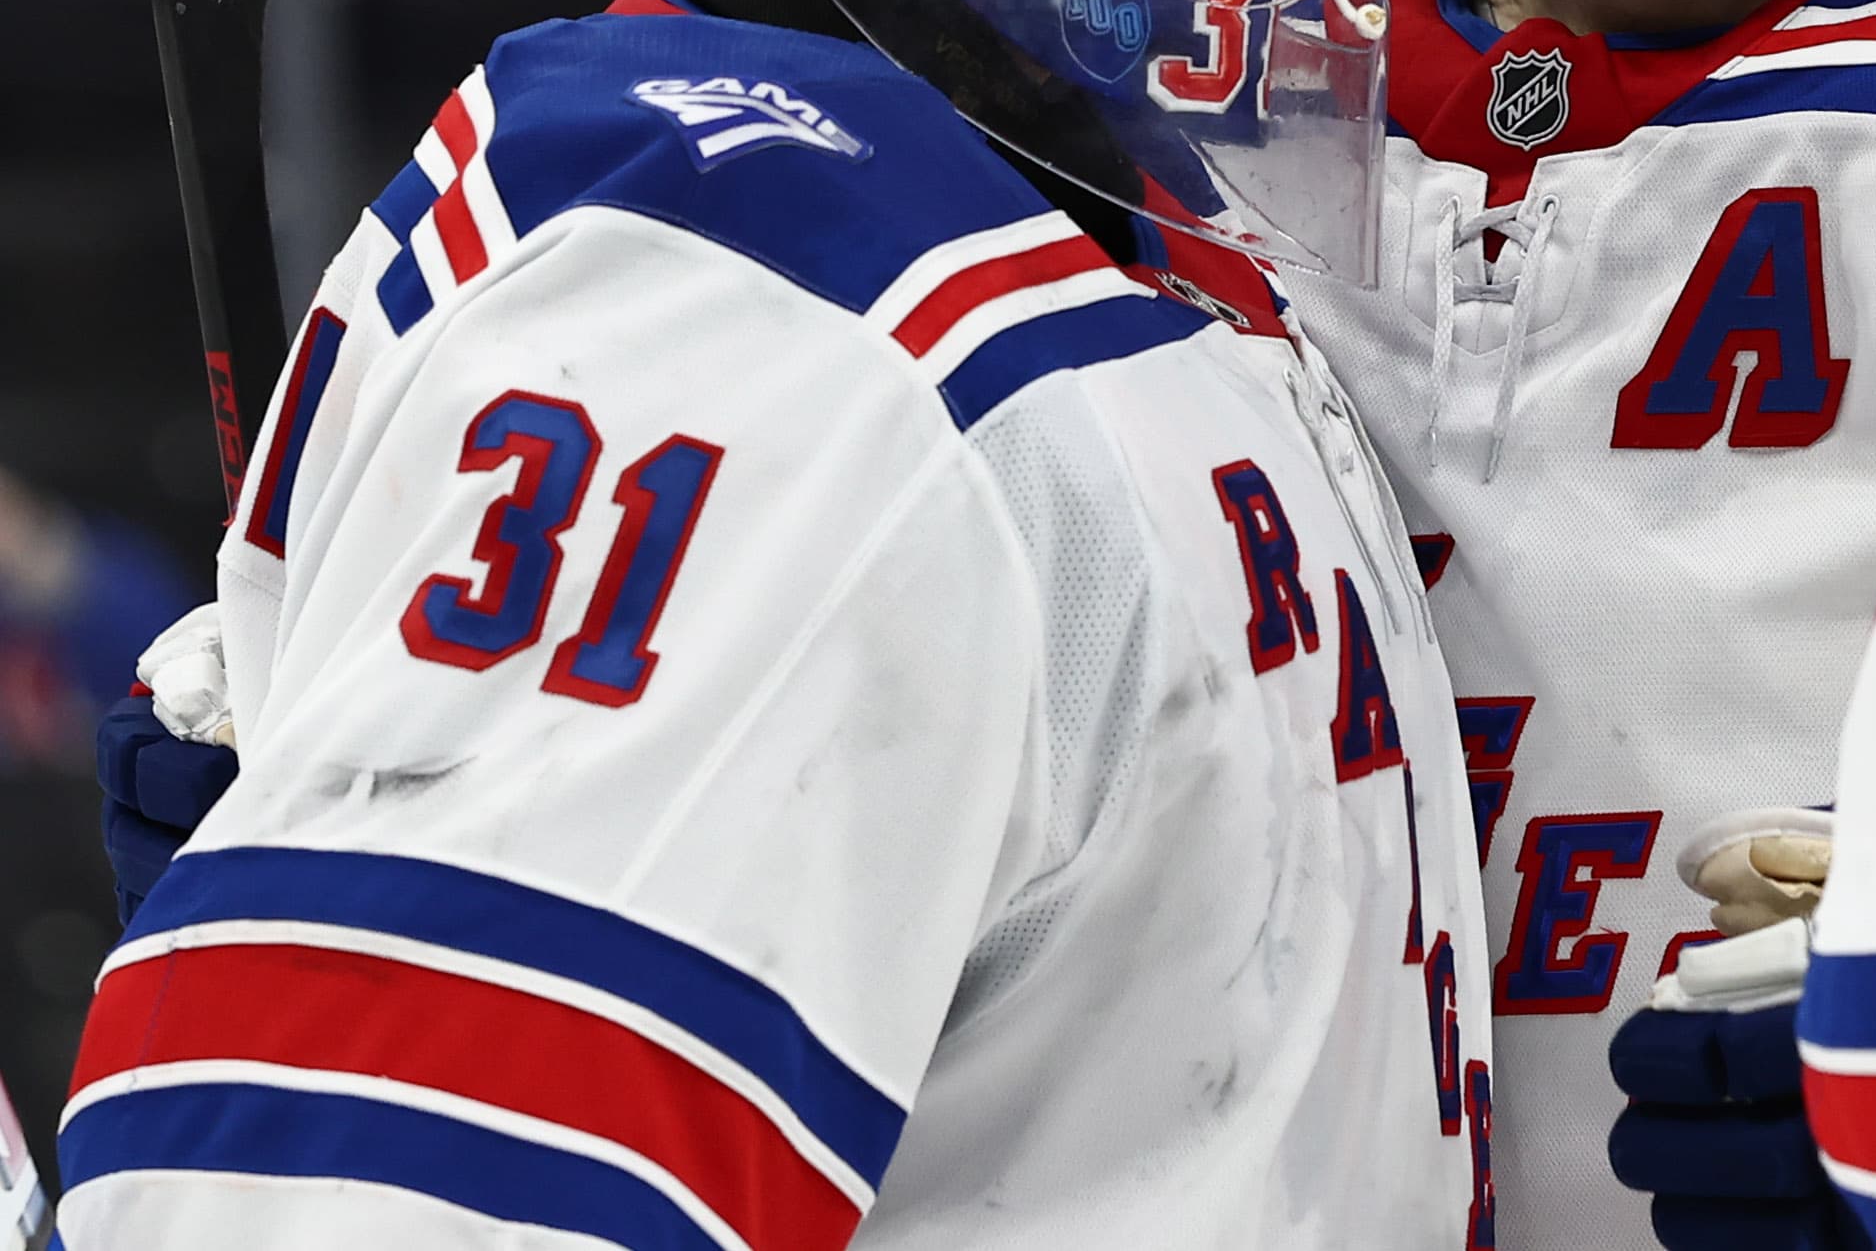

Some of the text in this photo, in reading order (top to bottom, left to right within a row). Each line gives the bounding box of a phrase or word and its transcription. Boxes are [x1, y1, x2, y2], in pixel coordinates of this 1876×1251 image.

[1506, 75, 1555, 128] NHL
[1611, 186, 1851, 451] A
[399, 388, 725, 709] 31
